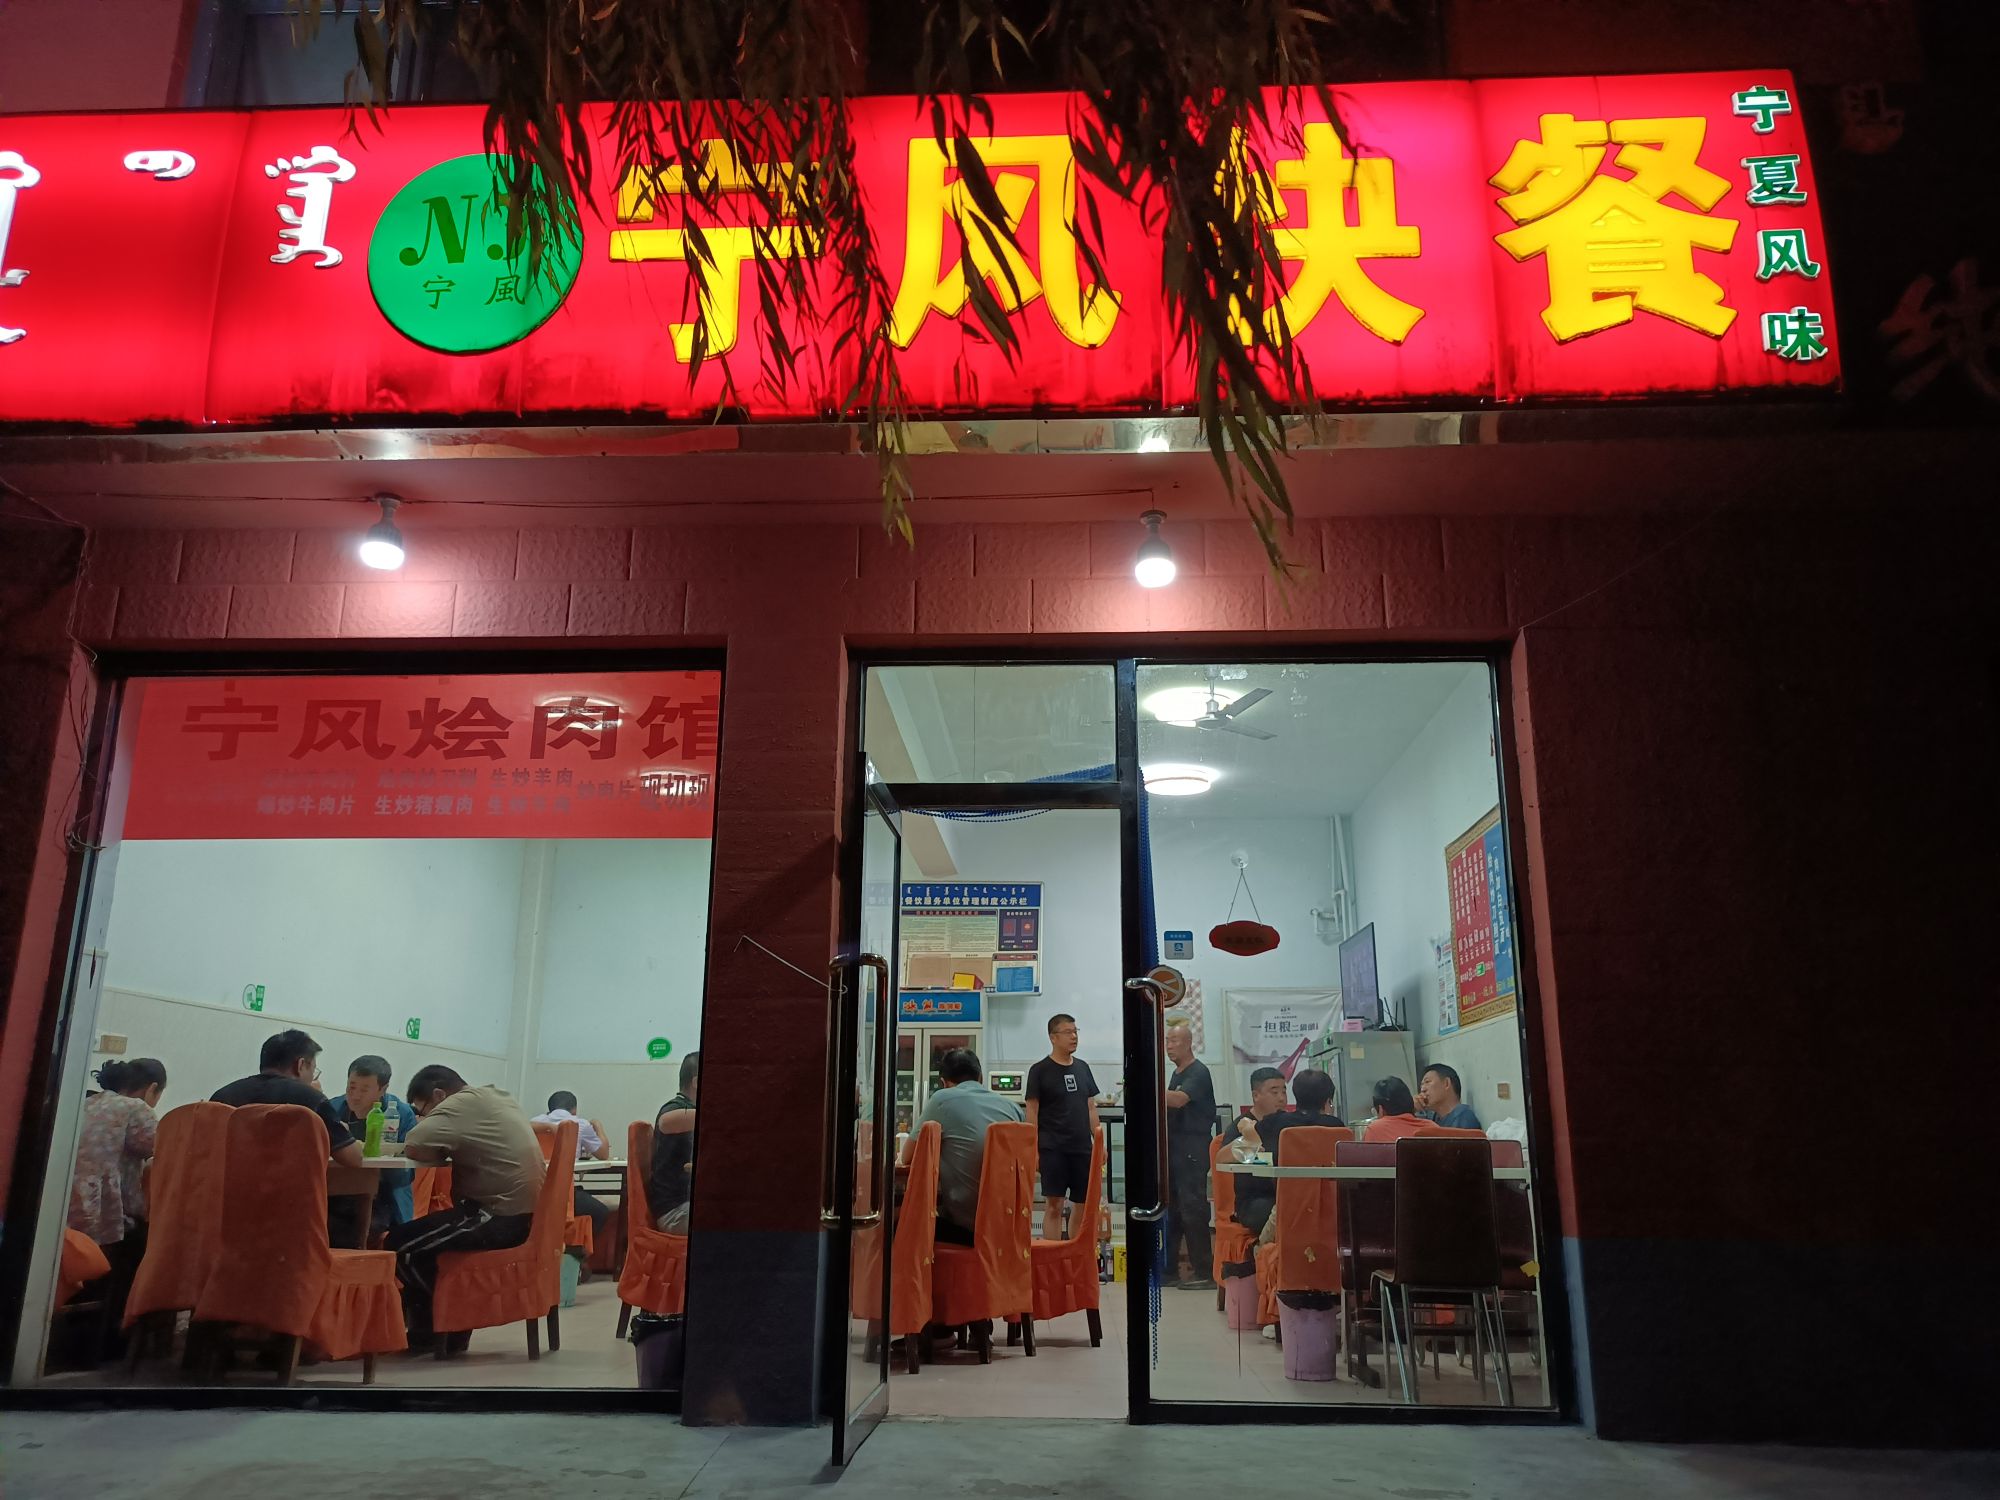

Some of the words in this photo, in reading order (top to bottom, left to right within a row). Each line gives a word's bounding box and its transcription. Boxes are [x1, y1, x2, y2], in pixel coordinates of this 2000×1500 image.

[1730, 84, 1828, 362] 宁夏风味
[181, 696, 719, 761] 宁风烩肉馆
